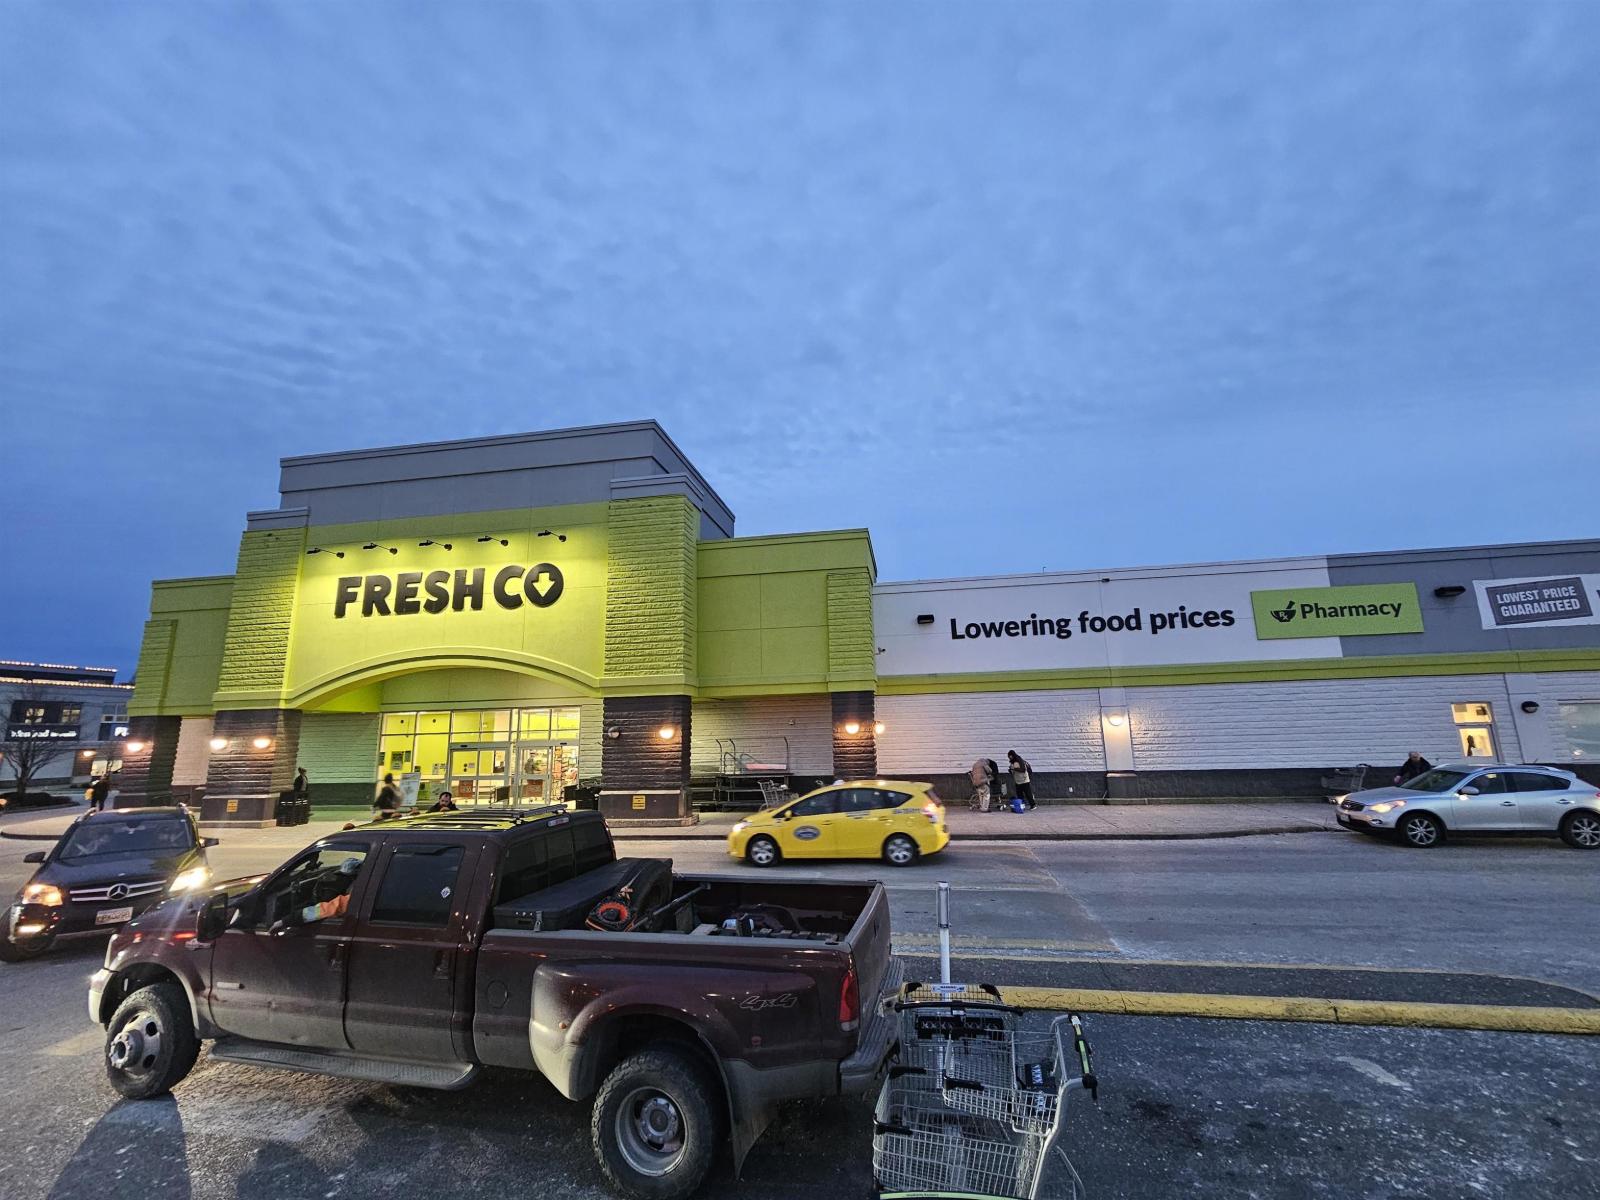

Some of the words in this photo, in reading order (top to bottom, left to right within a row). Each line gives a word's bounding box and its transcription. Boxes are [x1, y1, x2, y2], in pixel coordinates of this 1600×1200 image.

[334, 567, 485, 619] FRESH
[493, 562, 565, 610] CO
[1496, 589, 1539, 604] LOWEST
[1543, 585, 1577, 599] PRICE
[1300, 602, 1402, 619] Pharmacy
[1500, 598, 1581, 617] GUARANTEED
[950, 613, 1072, 640] Lowering
[1078, 608, 1142, 633] food
[1149, 605, 1235, 634] prices
[738, 993, 798, 1011] 4x4
